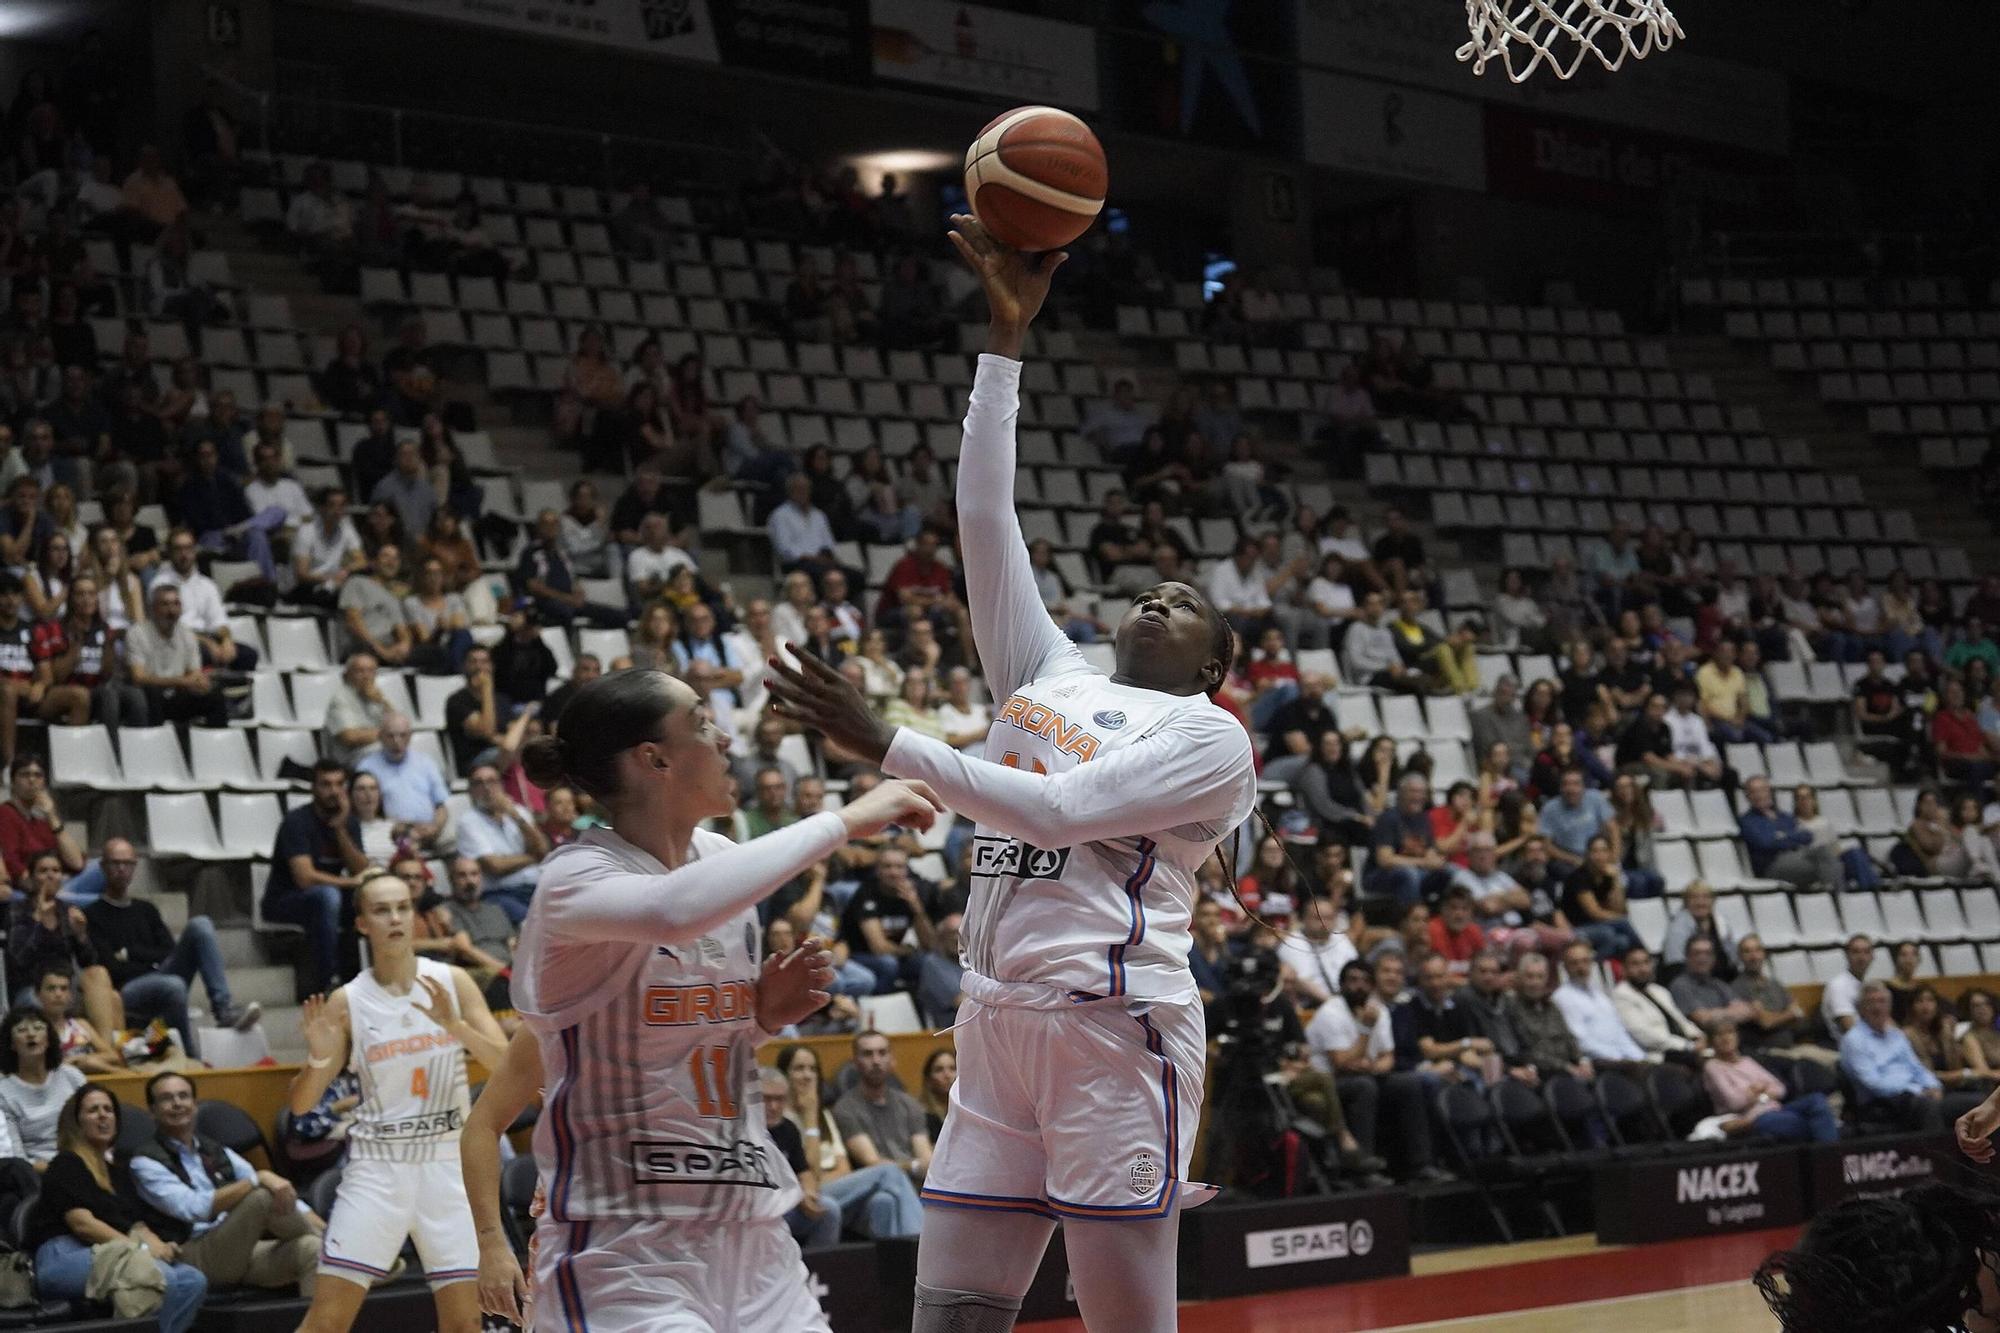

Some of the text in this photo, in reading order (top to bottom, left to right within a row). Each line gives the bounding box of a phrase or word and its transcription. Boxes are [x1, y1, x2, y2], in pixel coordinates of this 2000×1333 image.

[643, 979, 757, 1026] GIRON
[409, 1066, 430, 1100] 4
[688, 1045, 739, 1120] 11
[383, 1116, 446, 1135] SPAR
[1677, 1161, 1760, 1203] NACEX
[1271, 1229, 1345, 1257] SPAR
